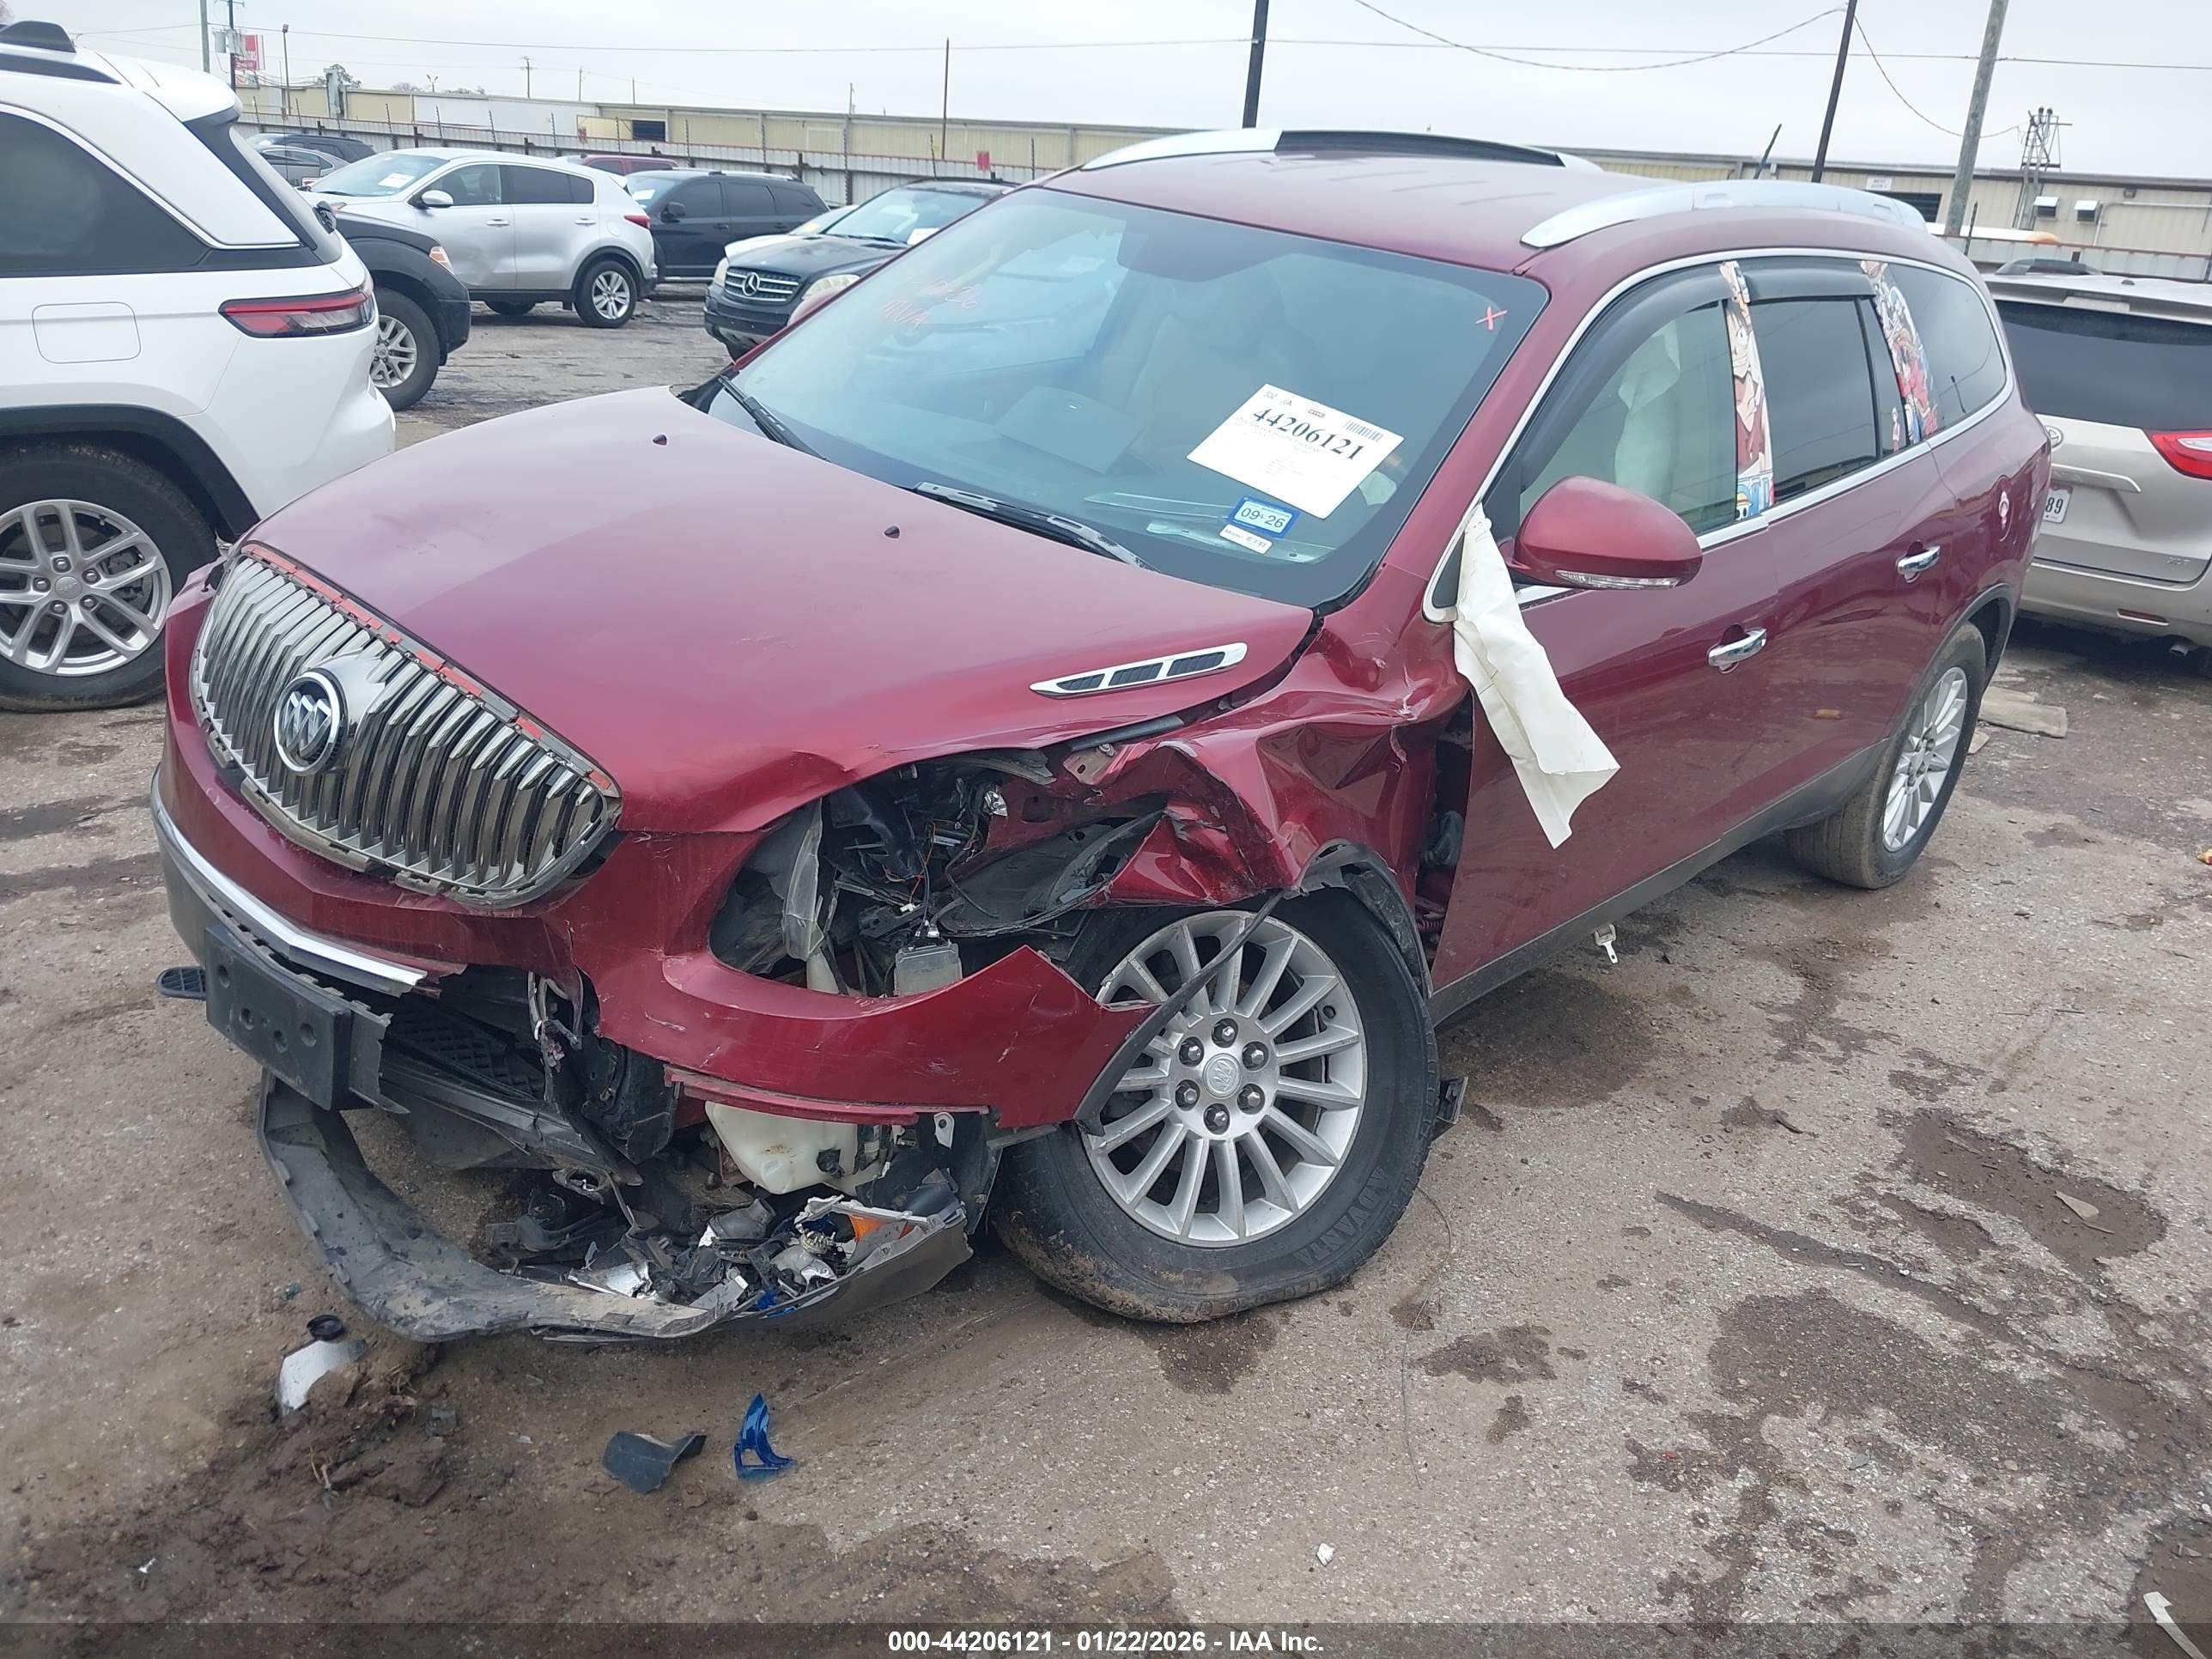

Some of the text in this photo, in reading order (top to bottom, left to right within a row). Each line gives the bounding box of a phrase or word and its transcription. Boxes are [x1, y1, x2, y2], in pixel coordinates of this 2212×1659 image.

[1253, 408, 1365, 461] 44206121
[1241, 507, 1261, 520] 09
[1264, 514, 1285, 528] 26
[2045, 496, 2064, 514] 89
[1292, 1165, 1389, 1267] ADVANTA
